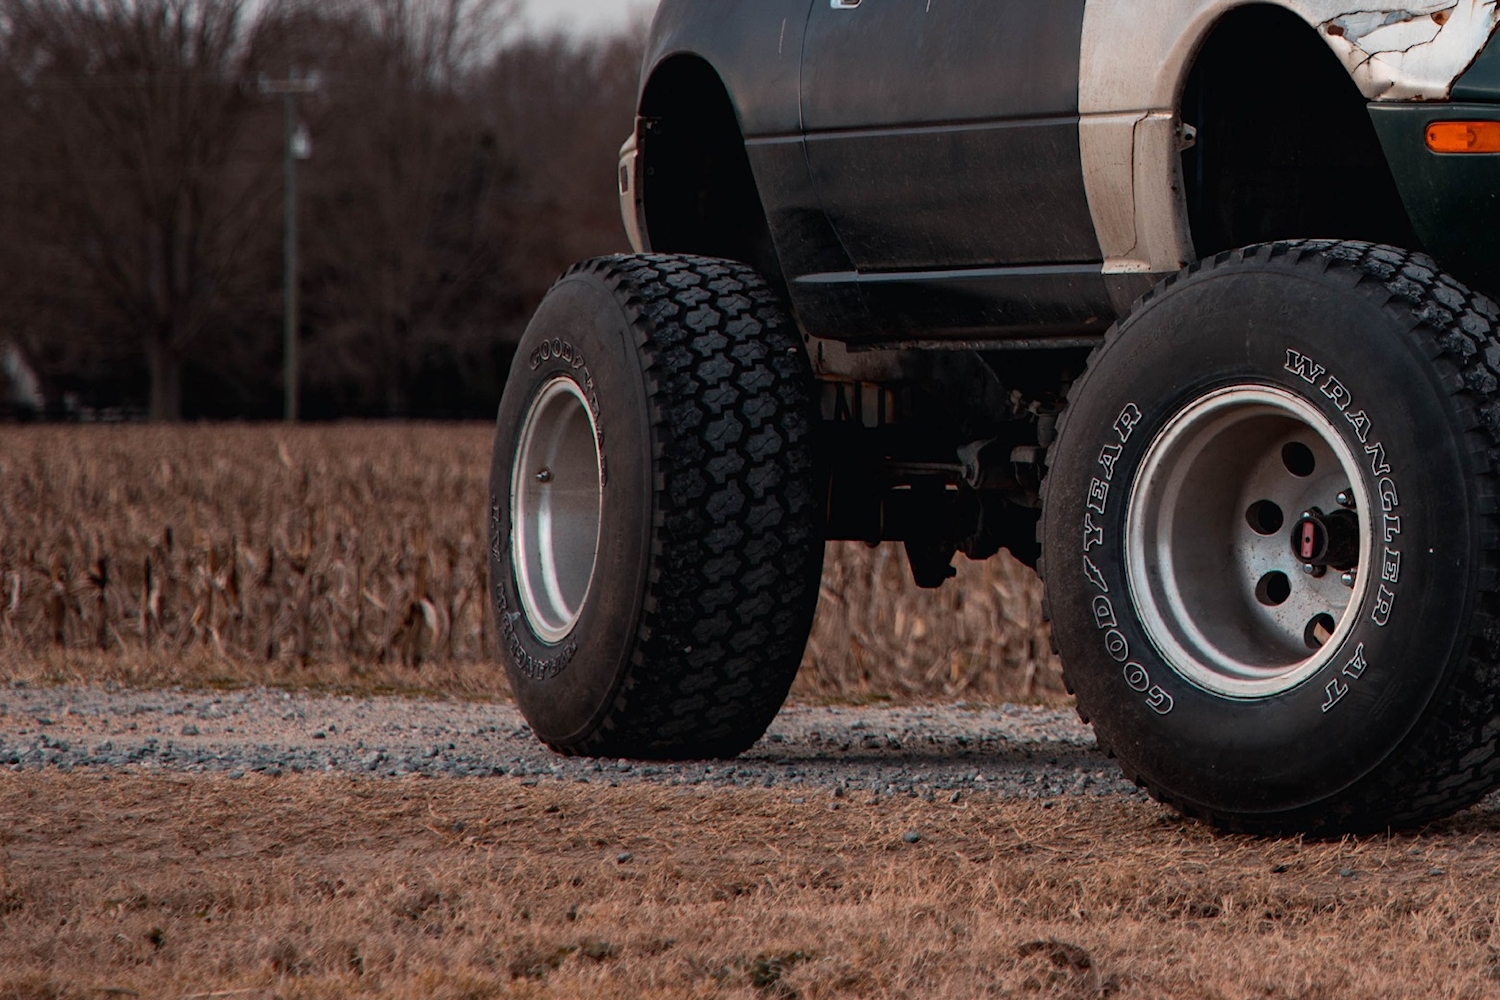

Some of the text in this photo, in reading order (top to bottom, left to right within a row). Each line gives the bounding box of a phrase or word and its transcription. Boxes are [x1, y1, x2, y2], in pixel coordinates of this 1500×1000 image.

[1083, 402, 1175, 716] GOODYEAR
[1284, 347, 1402, 714] WRANGLER AT
